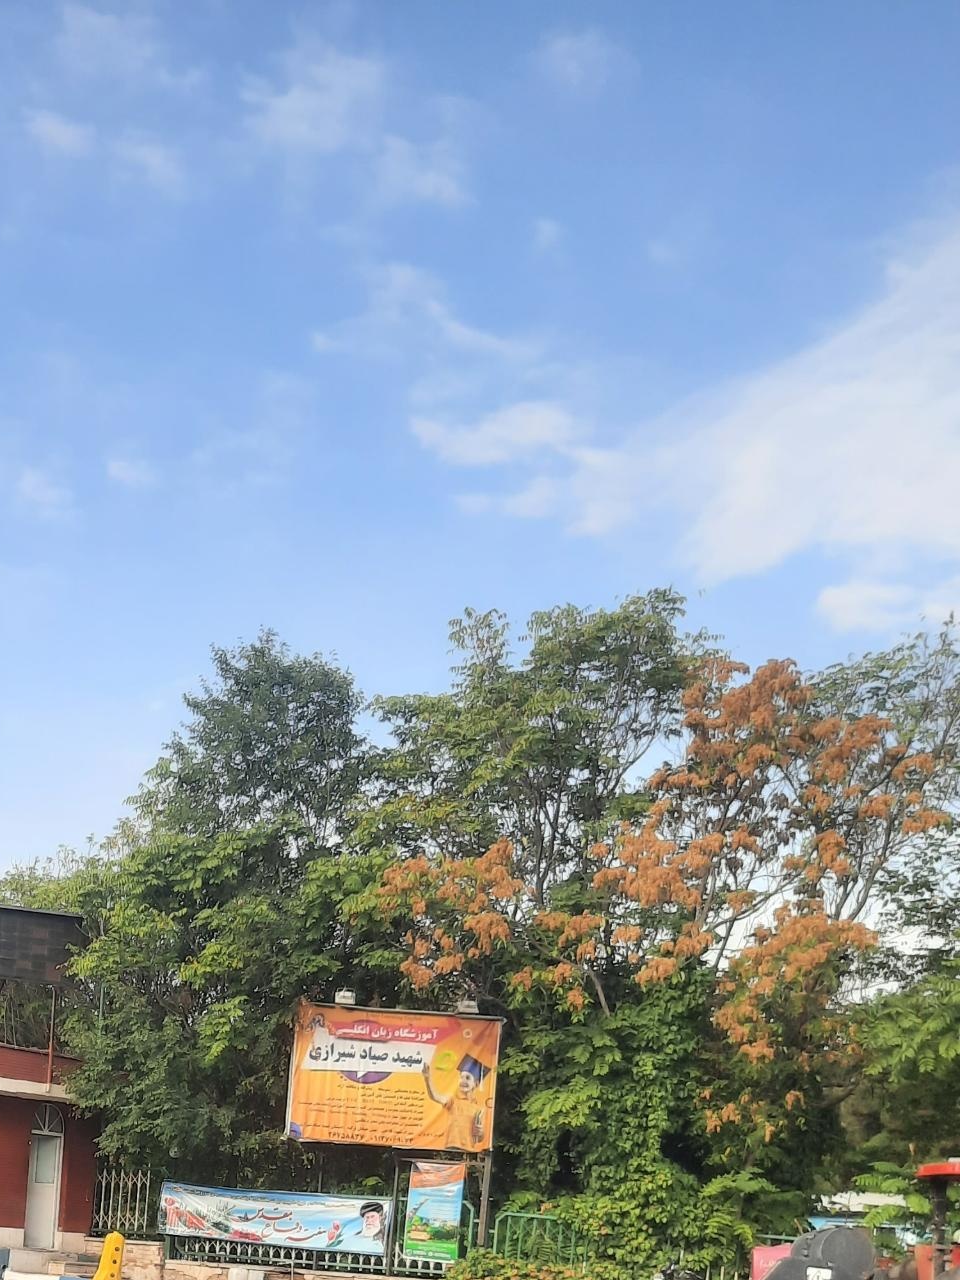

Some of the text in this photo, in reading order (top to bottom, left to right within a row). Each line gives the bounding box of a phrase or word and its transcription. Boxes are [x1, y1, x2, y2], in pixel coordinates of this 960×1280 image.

[336, 1024, 439, 1041] آموزشگاه زبان انگلیسی
[309, 1043, 423, 1068] شهید صیاد شیرازی
[230, 1207, 326, 1242] هفته دفاع مقدس
